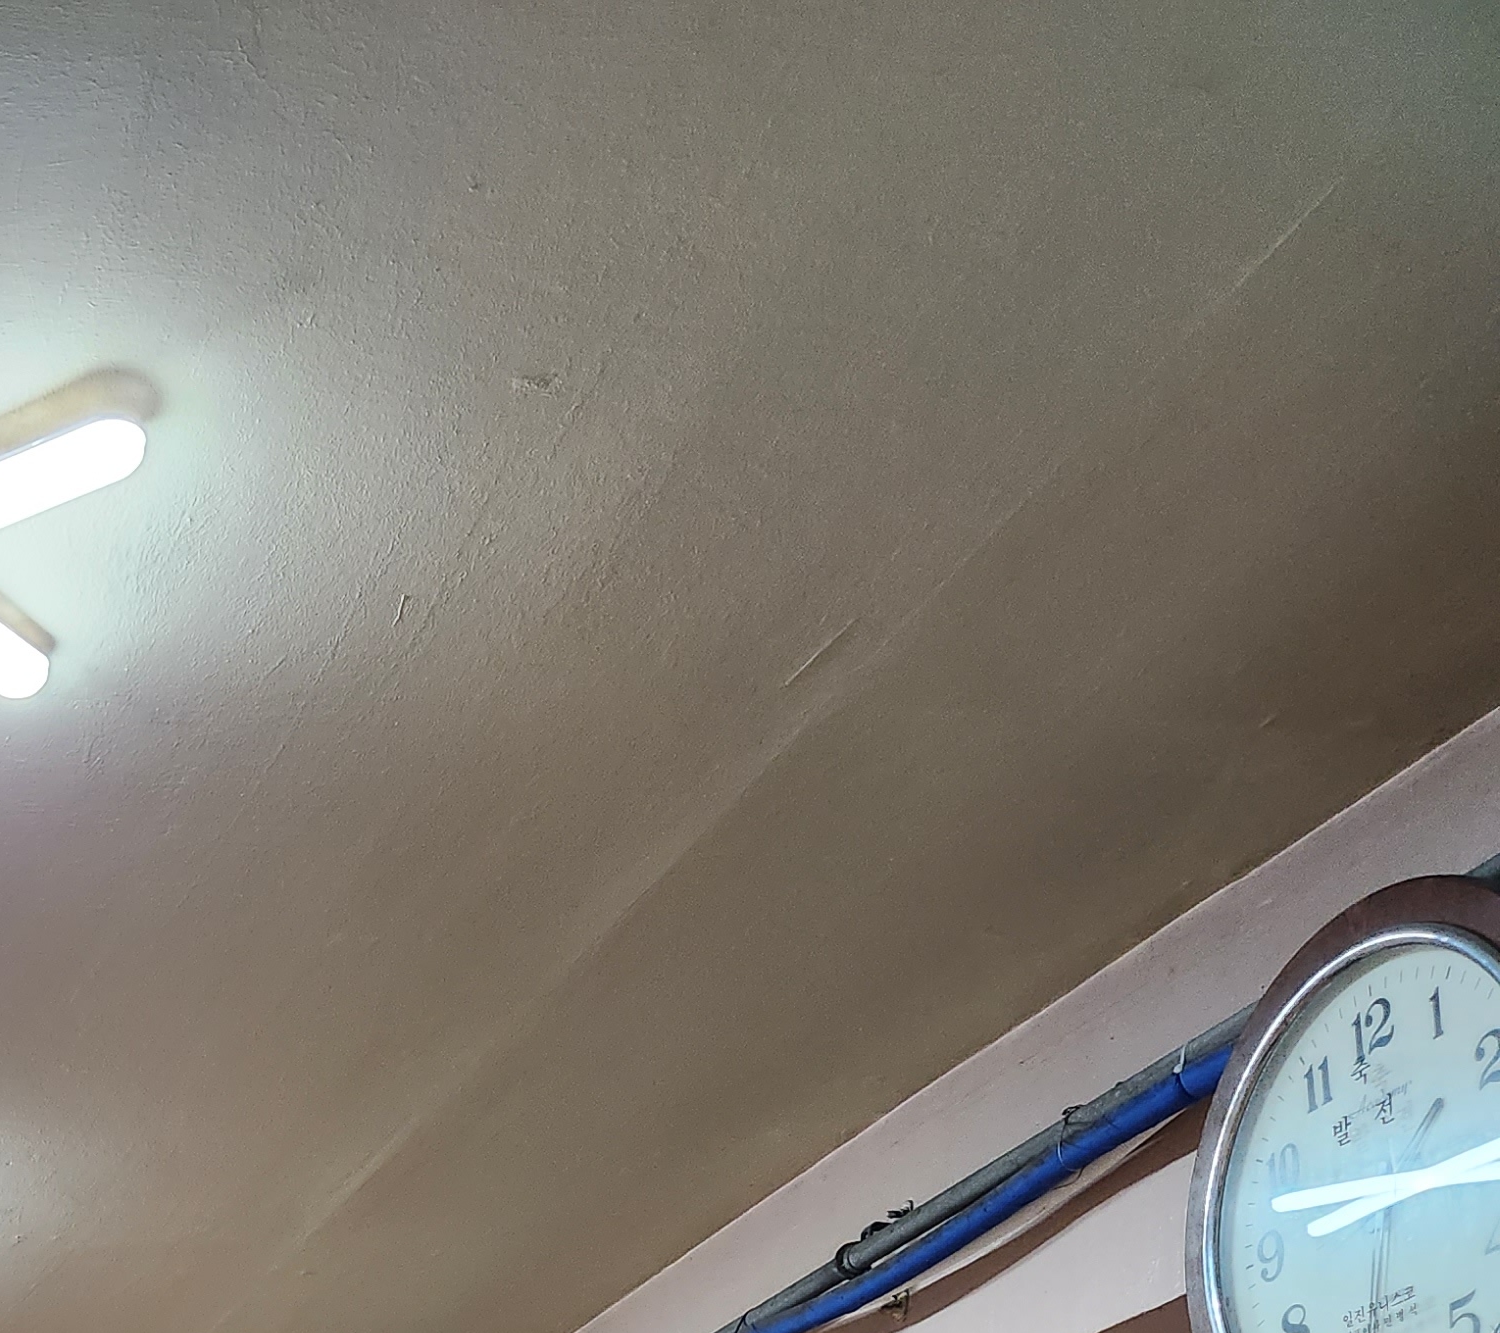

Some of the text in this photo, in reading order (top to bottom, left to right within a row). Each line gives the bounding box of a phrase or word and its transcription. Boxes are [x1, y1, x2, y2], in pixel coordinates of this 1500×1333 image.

[1351, 998, 1395, 1061] 12
[1429, 986, 1444, 1040] 1
[1303, 1055, 1334, 1114] 11
[1351, 1055, 1370, 1084] 축
[1266, 1143, 1299, 1190] 10
[1257, 1229, 1285, 1283] 9
